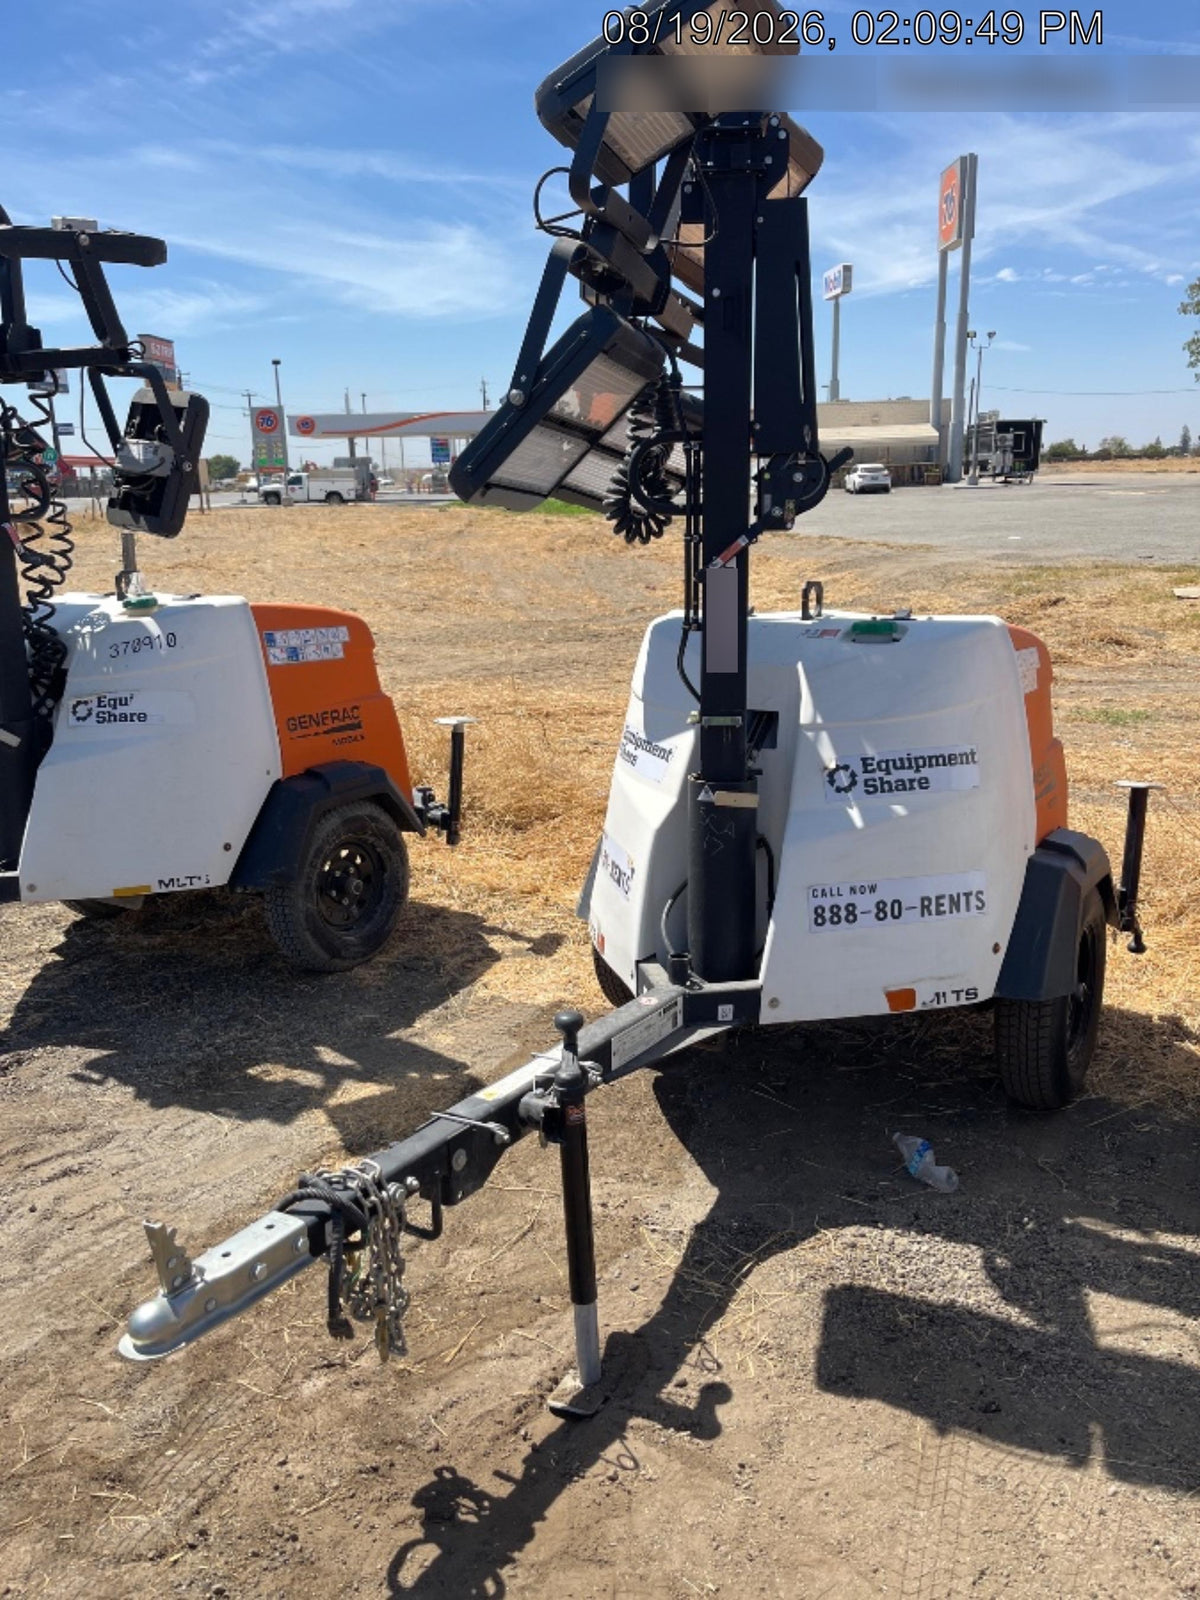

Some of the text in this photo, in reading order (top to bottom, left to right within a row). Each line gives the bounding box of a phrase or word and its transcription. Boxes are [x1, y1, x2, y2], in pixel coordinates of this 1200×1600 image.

[259, 414, 275, 430] 76
[109, 632, 177, 659] 370910
[95, 709, 148, 724] Share
[286, 704, 361, 733] GENERAC
[860, 747, 978, 776] Equipment
[863, 775, 931, 796] Share
[811, 883, 878, 899] CALL NOW
[813, 889, 987, 927] 888-80-RENTS
